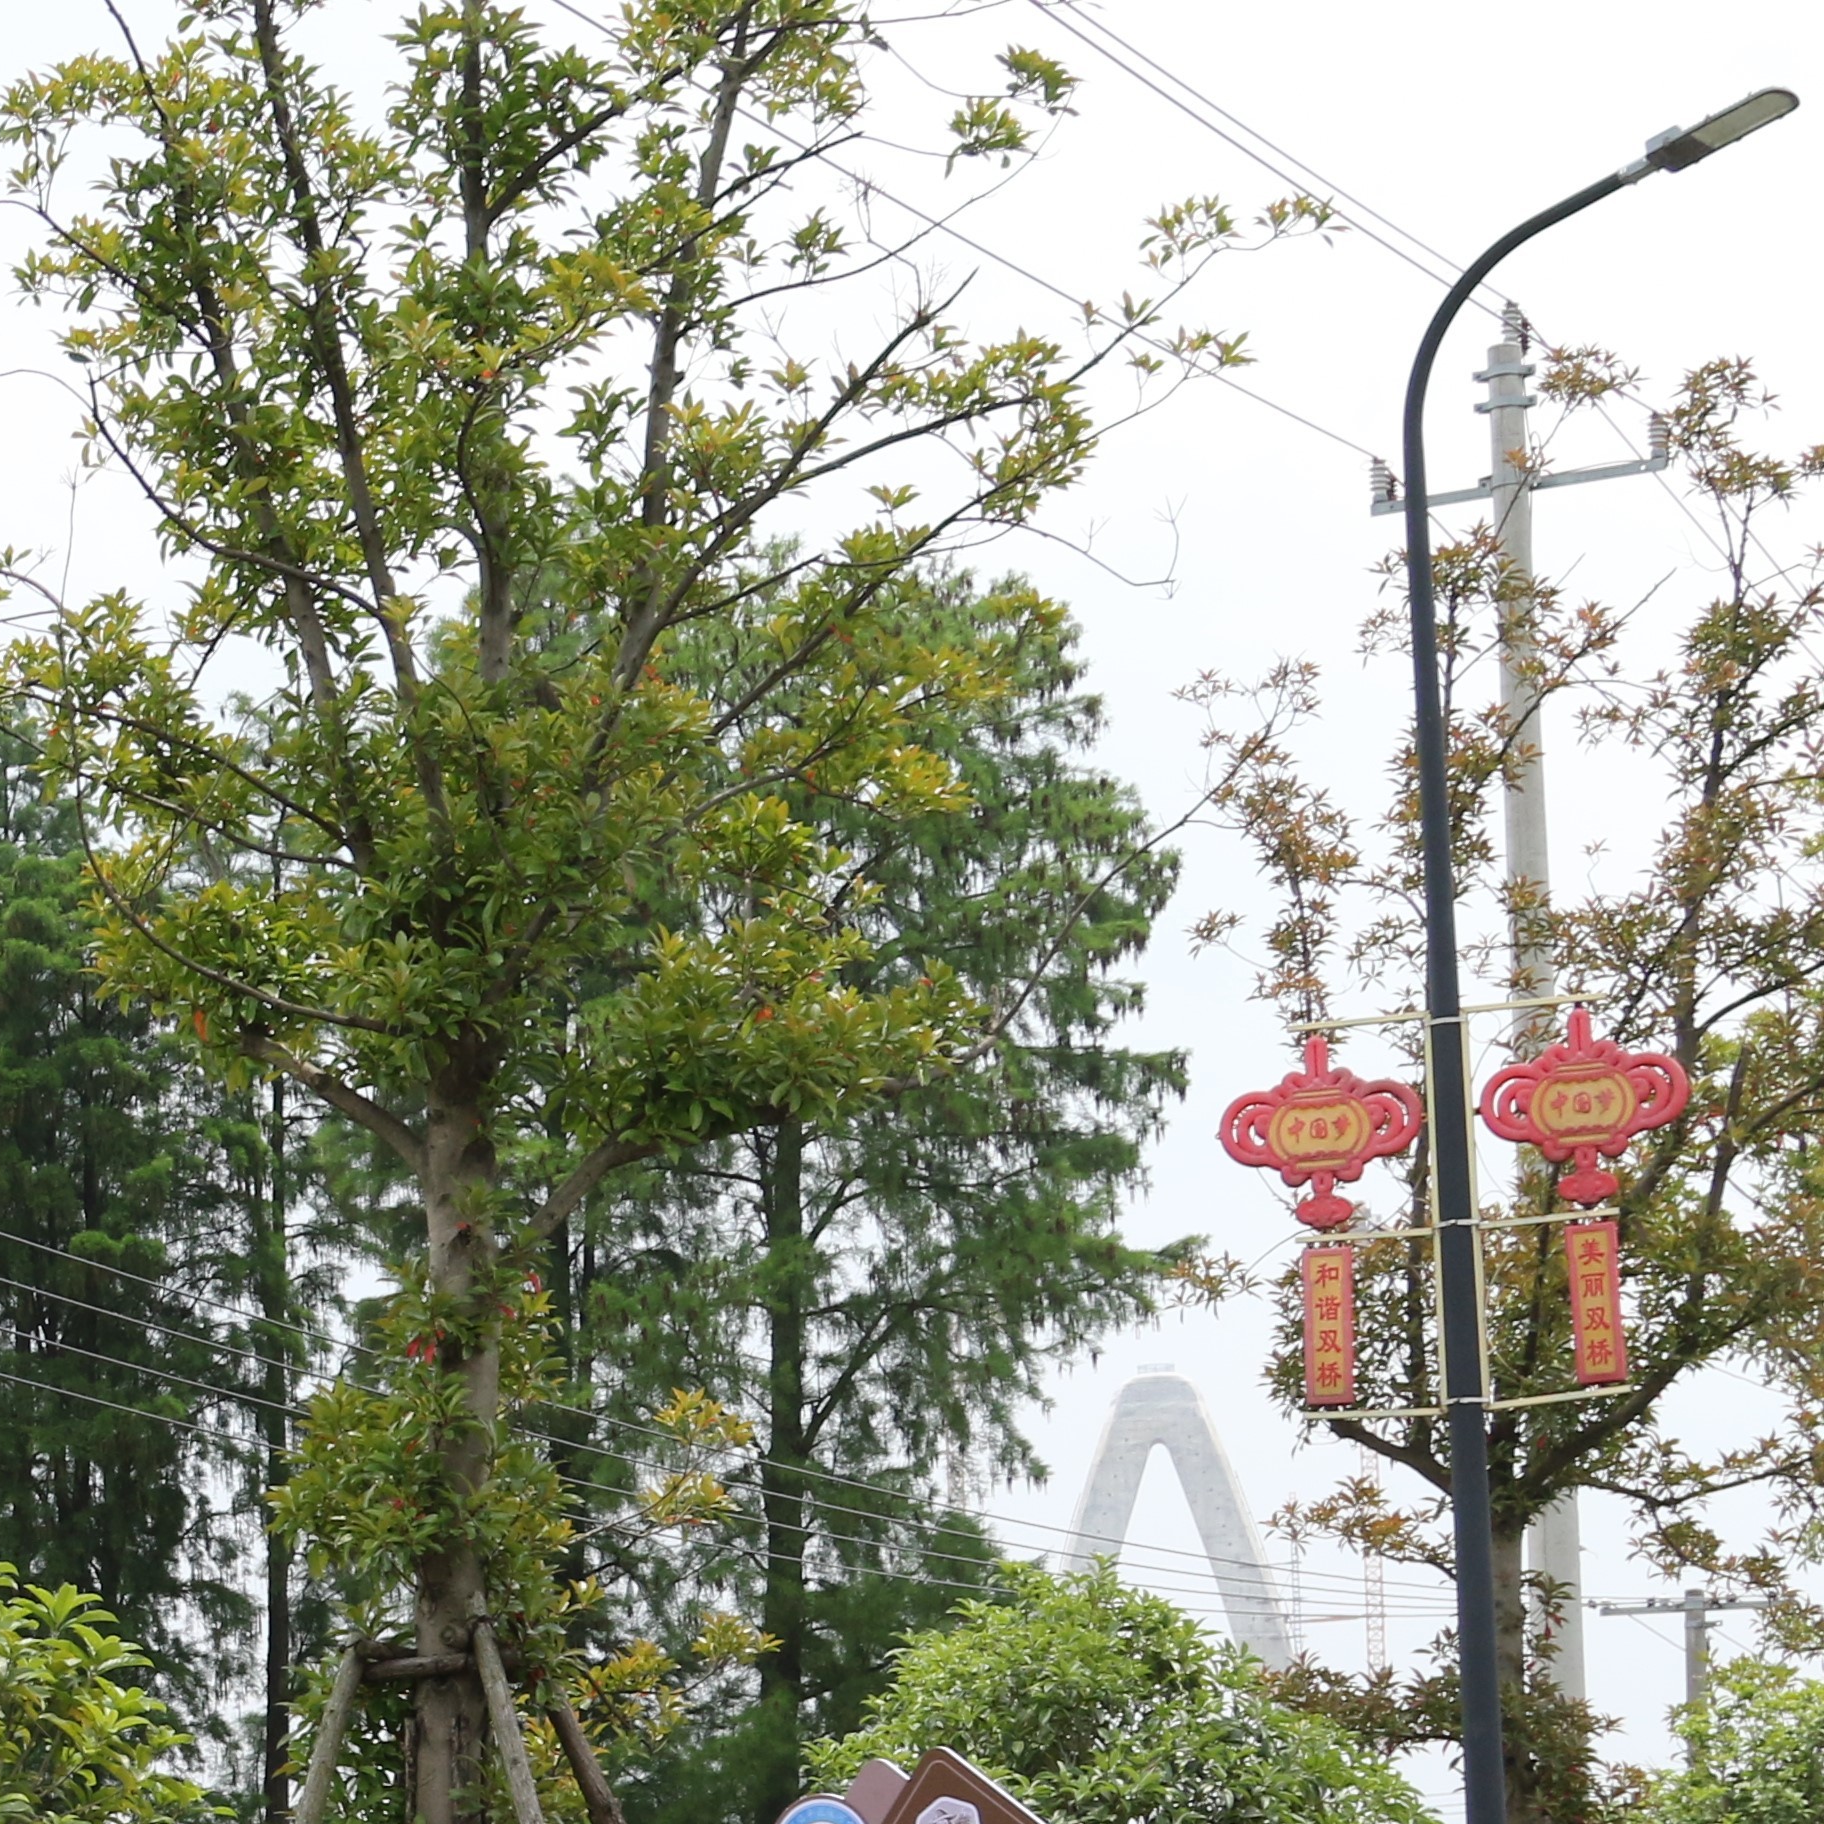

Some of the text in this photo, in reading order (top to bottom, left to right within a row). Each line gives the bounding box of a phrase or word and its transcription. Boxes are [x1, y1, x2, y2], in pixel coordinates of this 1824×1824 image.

[1314, 1263, 1342, 1387] 和谐双桥
[1579, 1239, 1613, 1366] 美丽双桥
